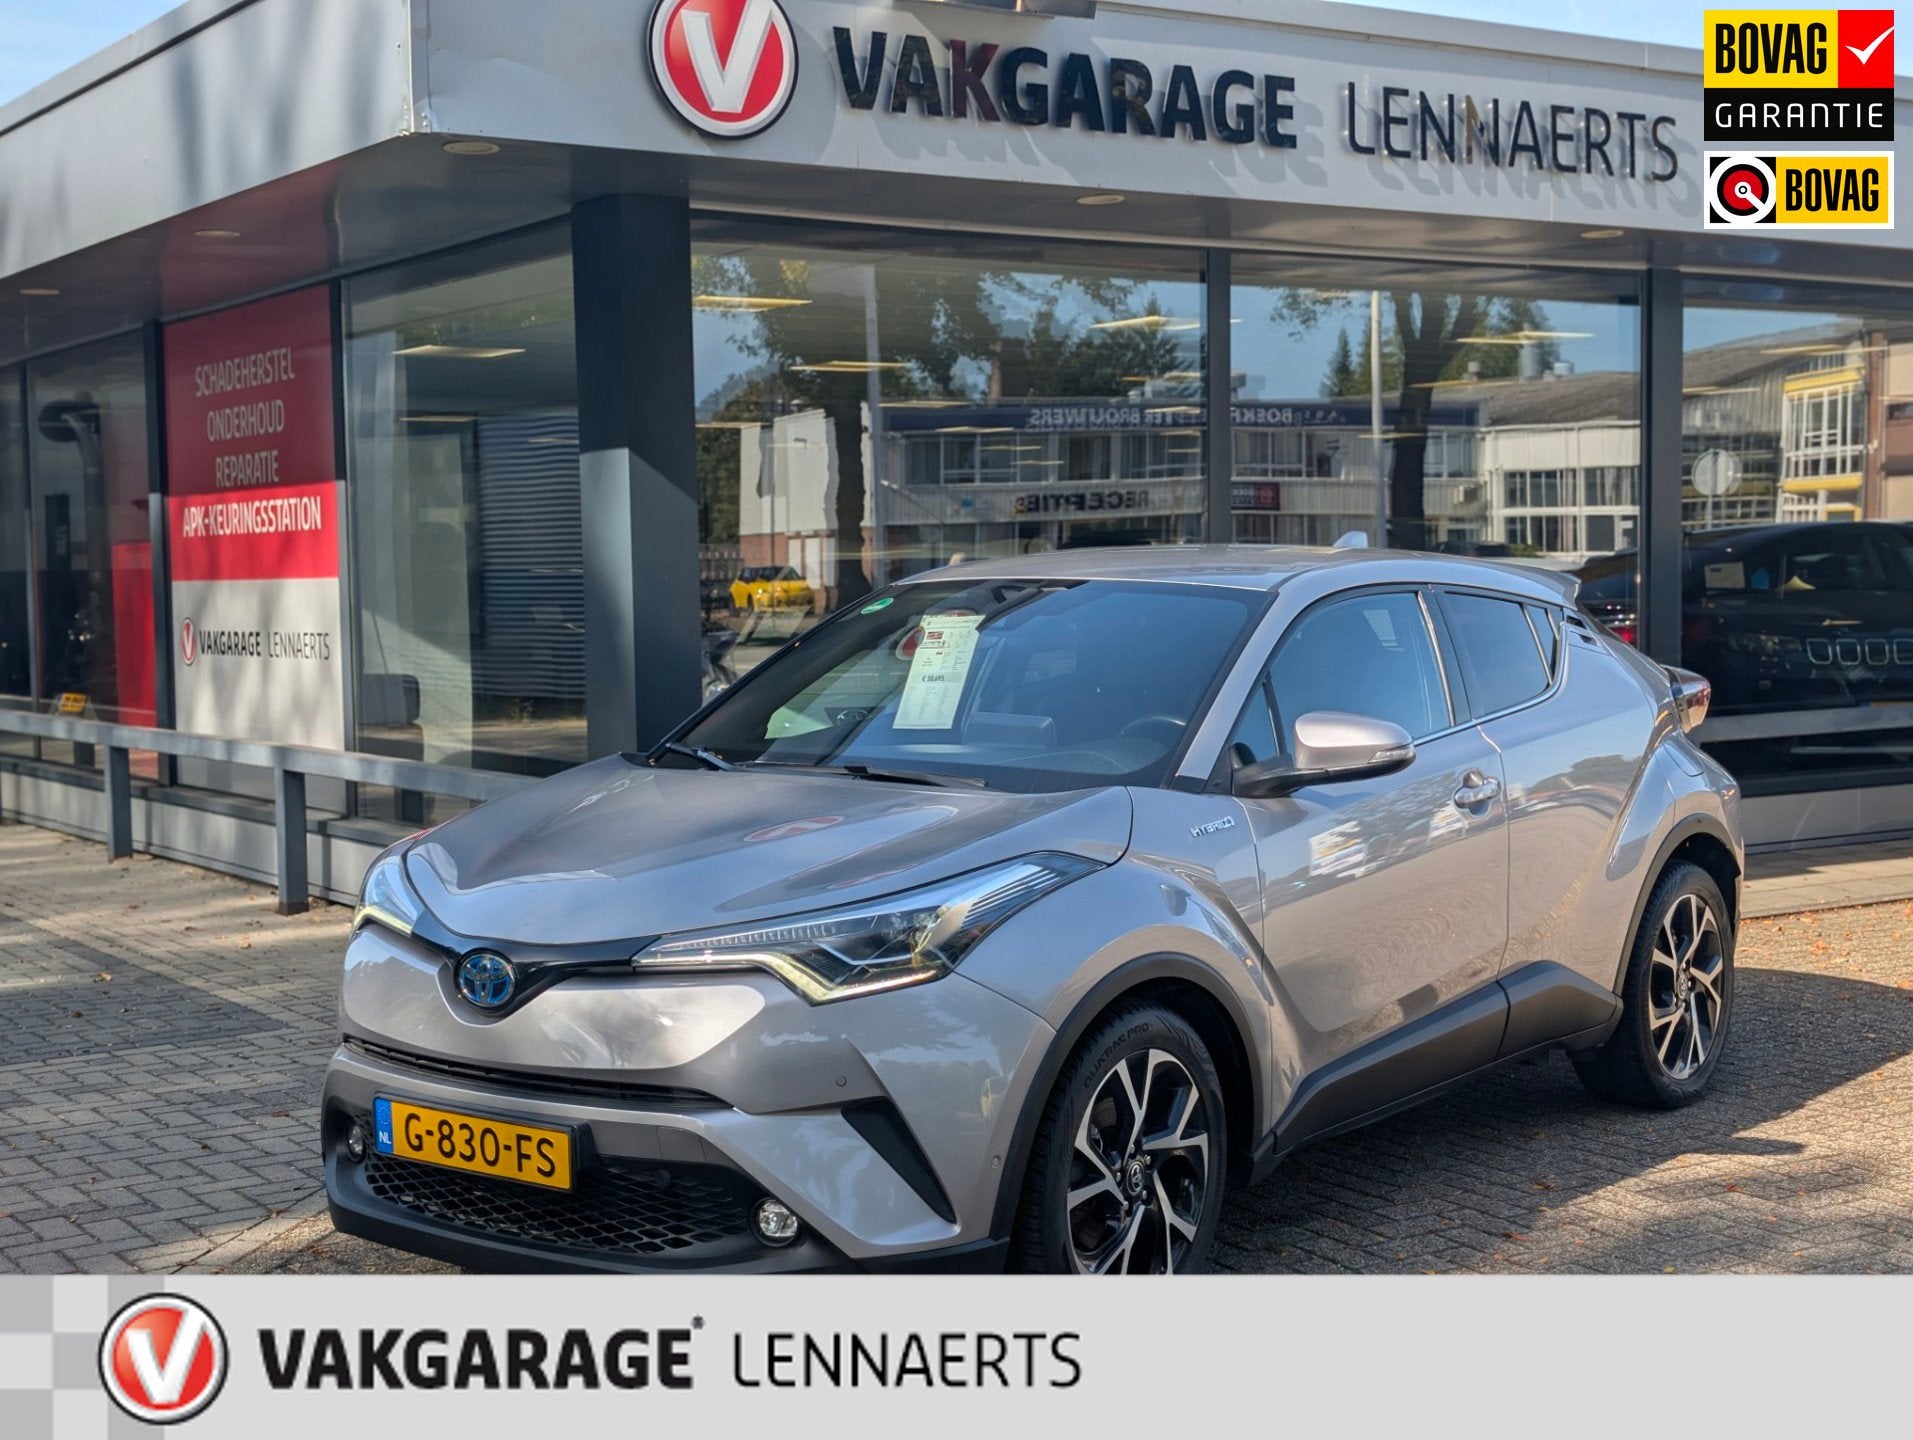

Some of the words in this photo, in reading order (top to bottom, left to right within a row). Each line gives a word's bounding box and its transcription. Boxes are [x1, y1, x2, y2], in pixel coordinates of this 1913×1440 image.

[833, 26, 1297, 149] VAKGARAGE
[1346, 82, 1679, 183] LENNAERTS
[195, 347, 295, 398] SCHADEHERSTEL
[207, 400, 285, 442] ONDERHOUD
[215, 450, 280, 488] REPARATIE
[183, 496, 321, 538] APK-KEURINGSSTATION
[199, 630, 261, 657] VAKGARAGE
[267, 632, 331, 661] LENNAERTS
[379, 1131, 391, 1145] NL
[405, 1112, 556, 1178] G-830-FS
